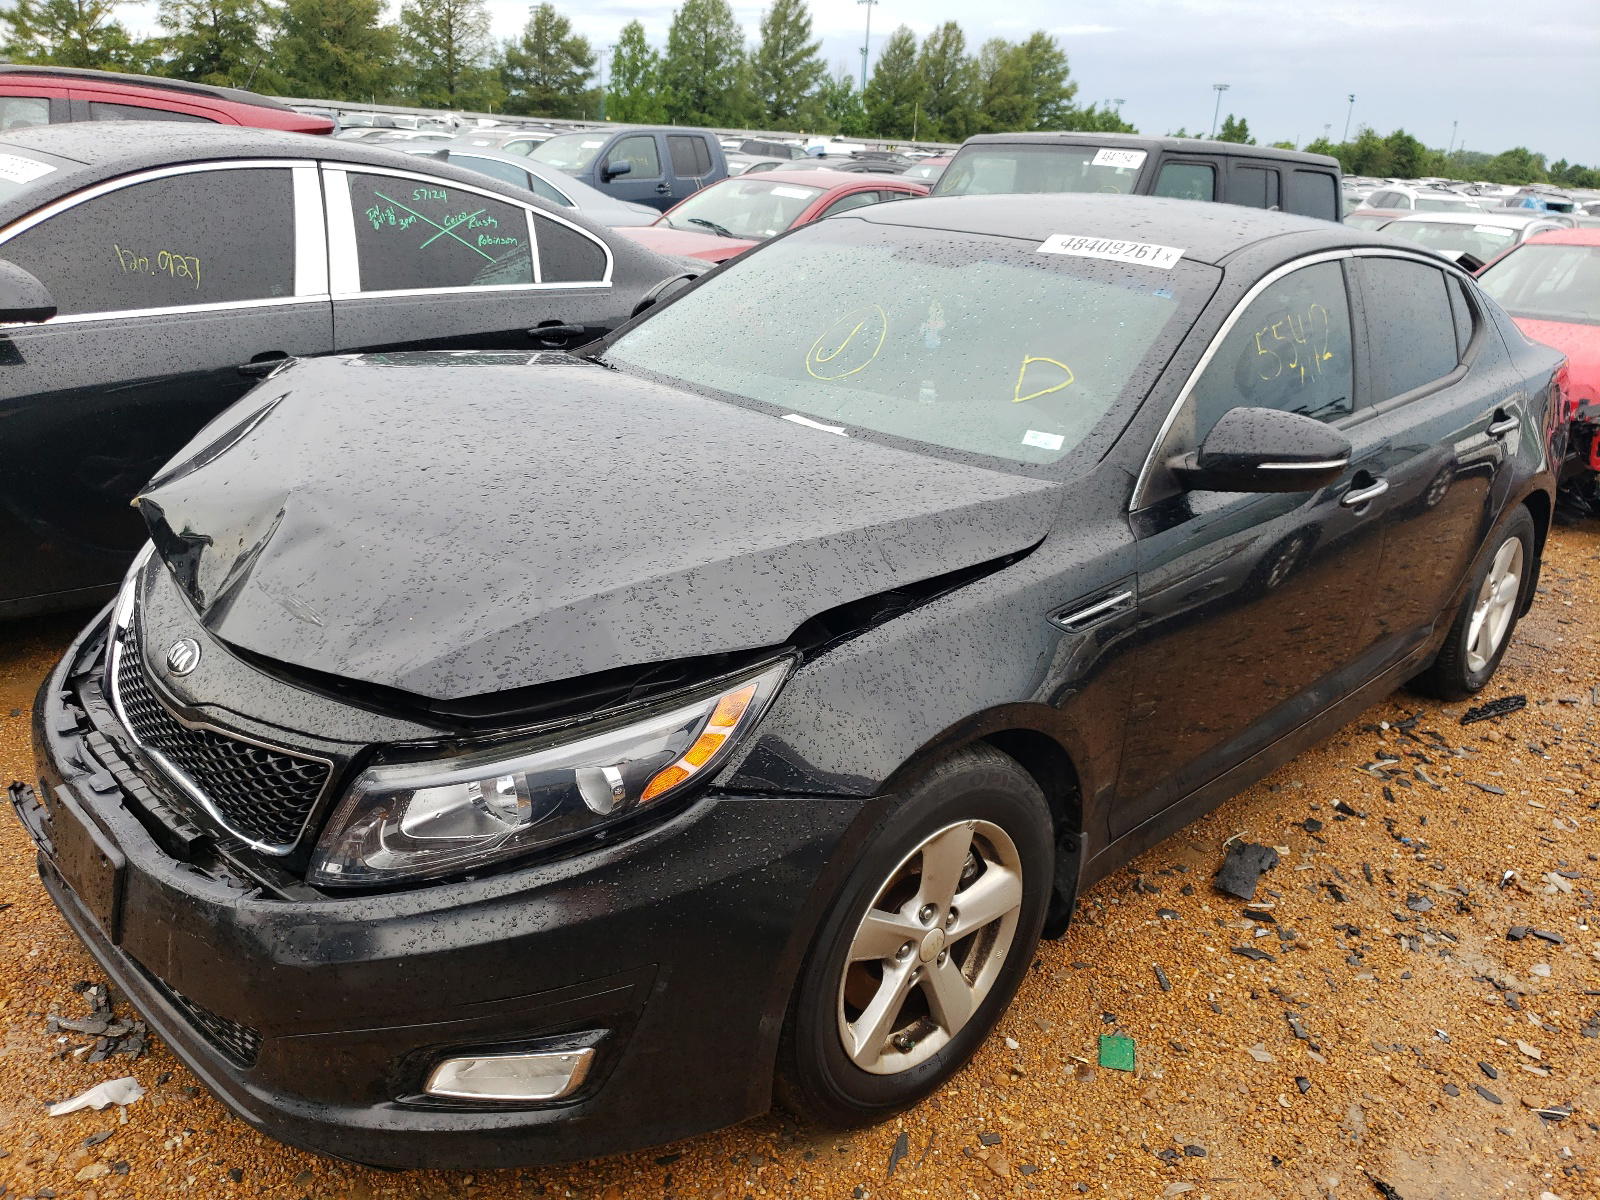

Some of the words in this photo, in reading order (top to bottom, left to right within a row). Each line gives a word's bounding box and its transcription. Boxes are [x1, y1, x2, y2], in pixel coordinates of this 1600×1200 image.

[412, 189, 447, 203] 57124
[468, 216, 498, 229] Rusty
[478, 234, 517, 246] Robinson
[1060, 237, 1163, 261] 48409261
[168, 642, 193, 671] KIA
